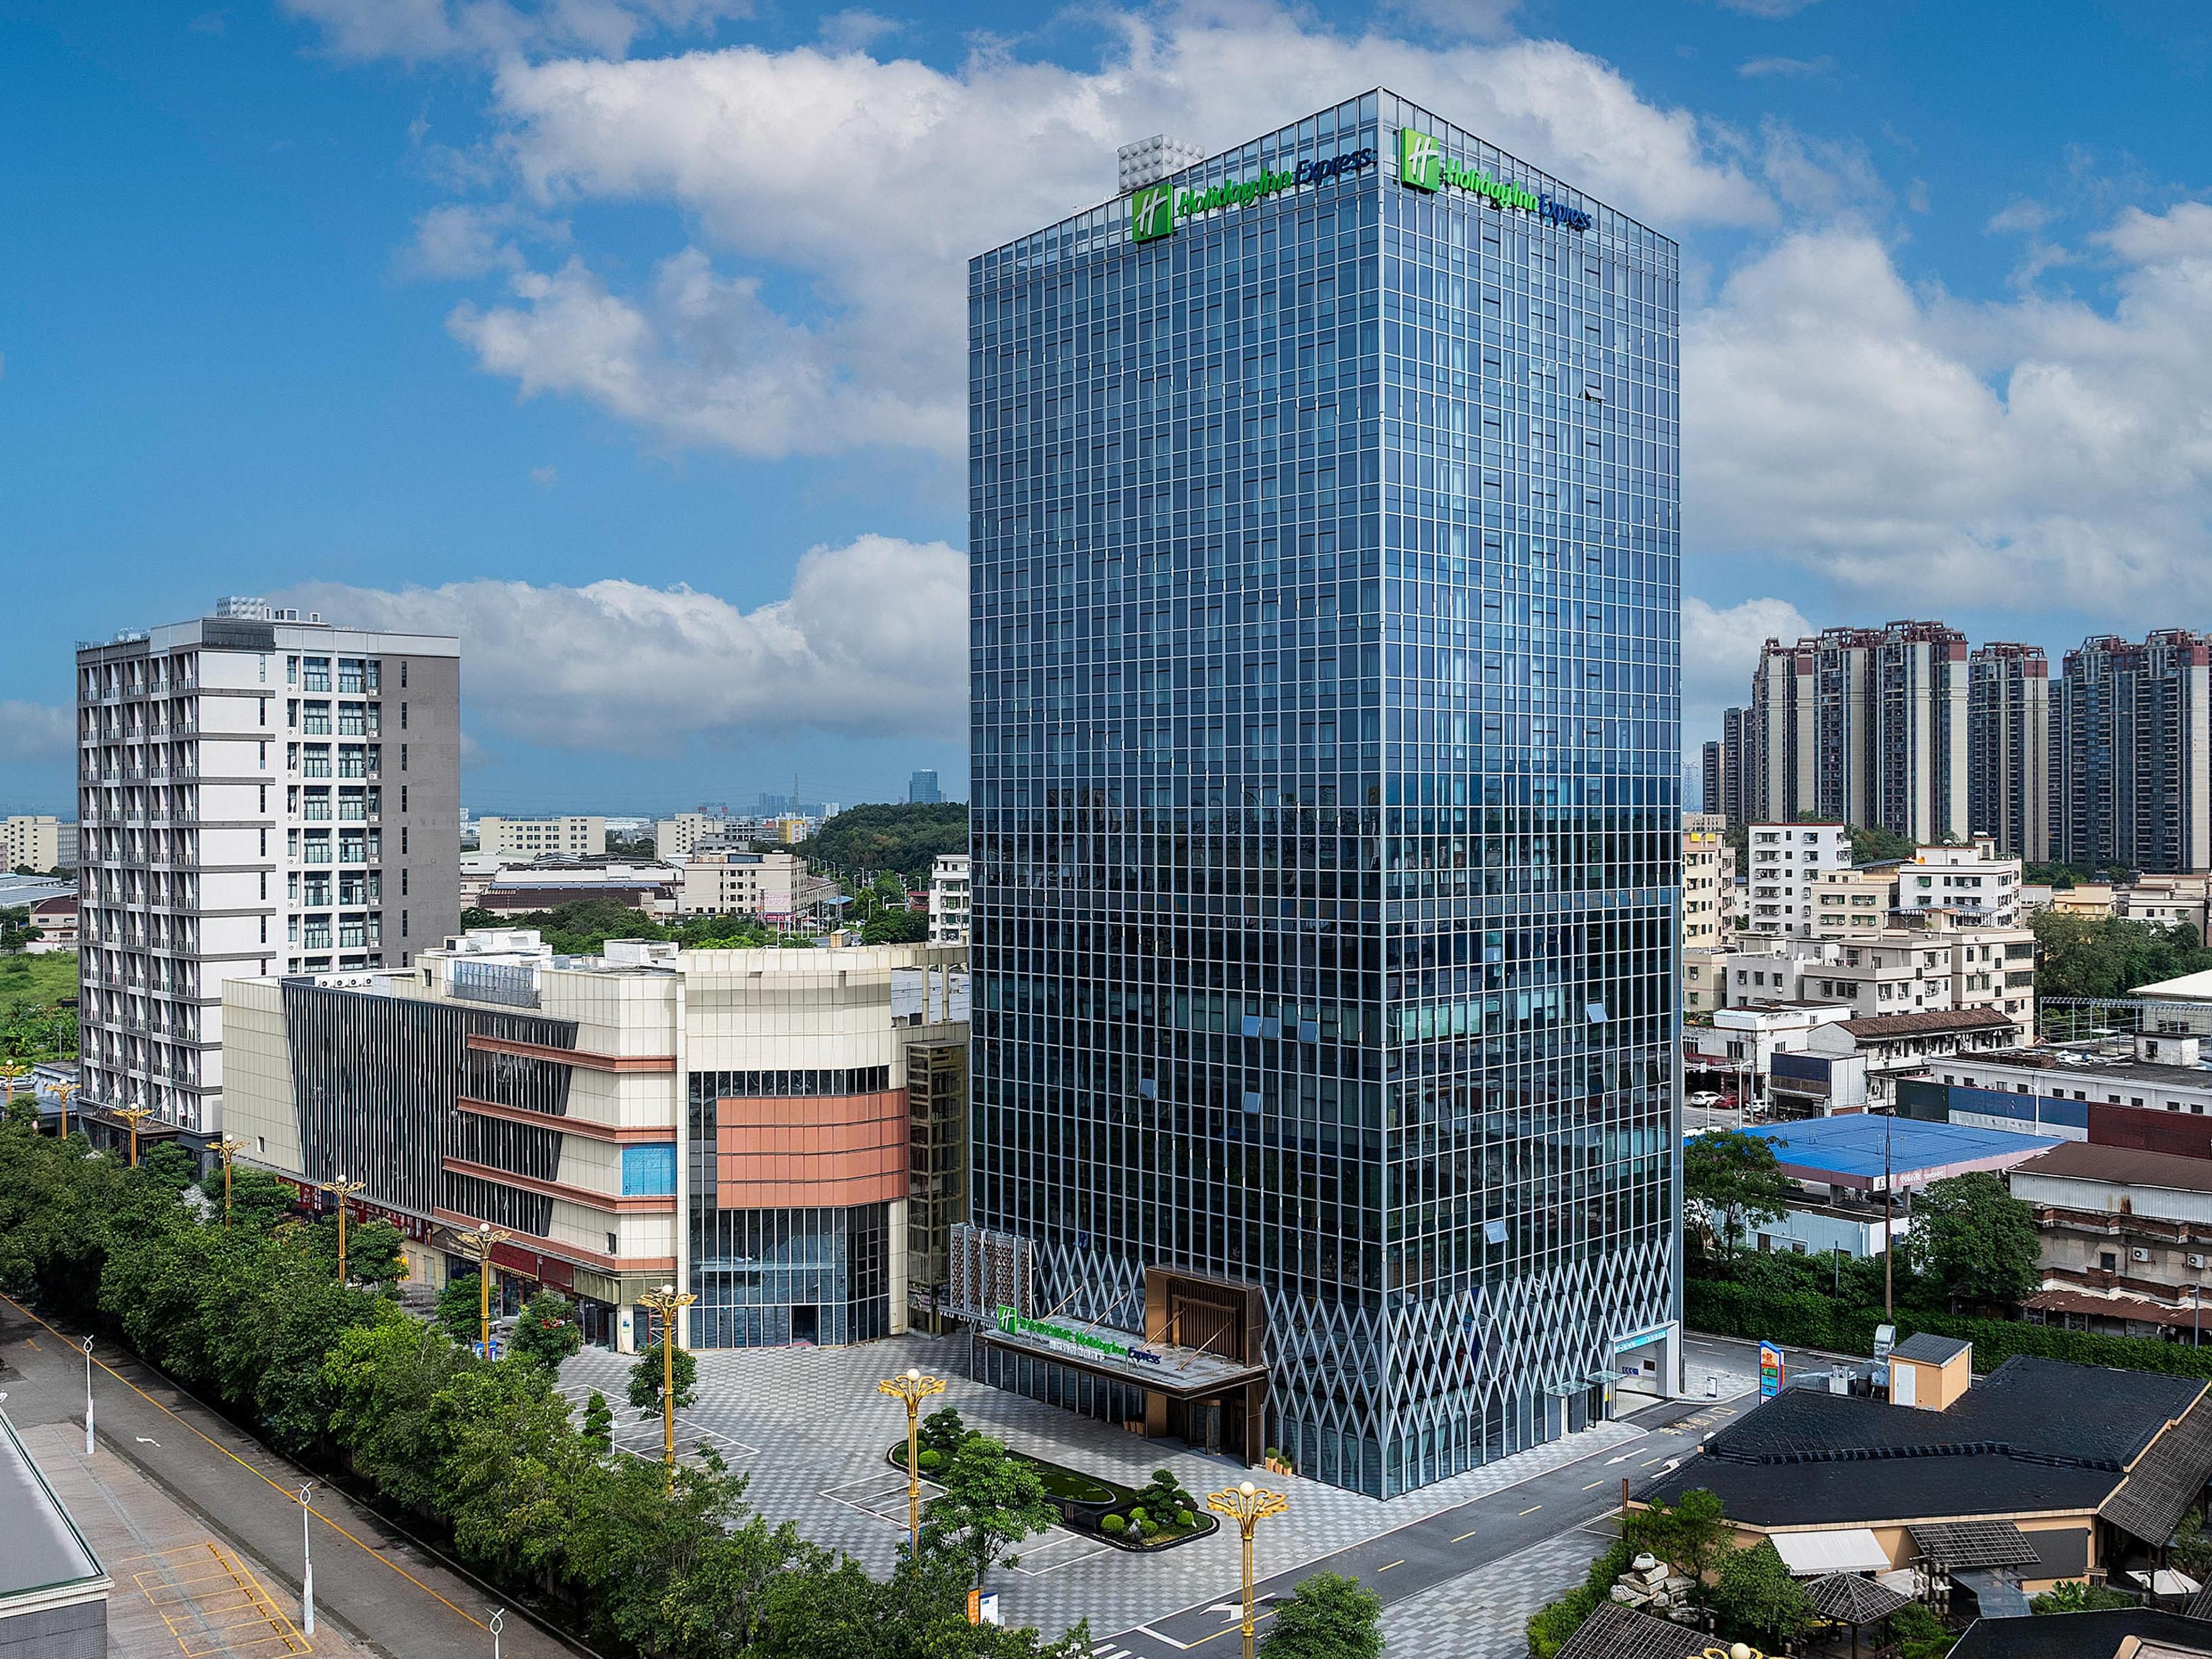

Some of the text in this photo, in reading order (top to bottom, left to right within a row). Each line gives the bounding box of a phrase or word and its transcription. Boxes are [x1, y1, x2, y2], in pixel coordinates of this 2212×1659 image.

[1177, 179, 1256, 218] Holiday
[1258, 168, 1292, 196] Inn
[1295, 147, 1372, 186] Express
[1443, 157, 1512, 208] Holiday
[1511, 180, 1539, 212] Inn
[1539, 193, 1592, 230] Express
[1075, 1331, 1112, 1355] Holiday
[1112, 1339, 1126, 1357] Inn
[1128, 1347, 1161, 1365] Express
